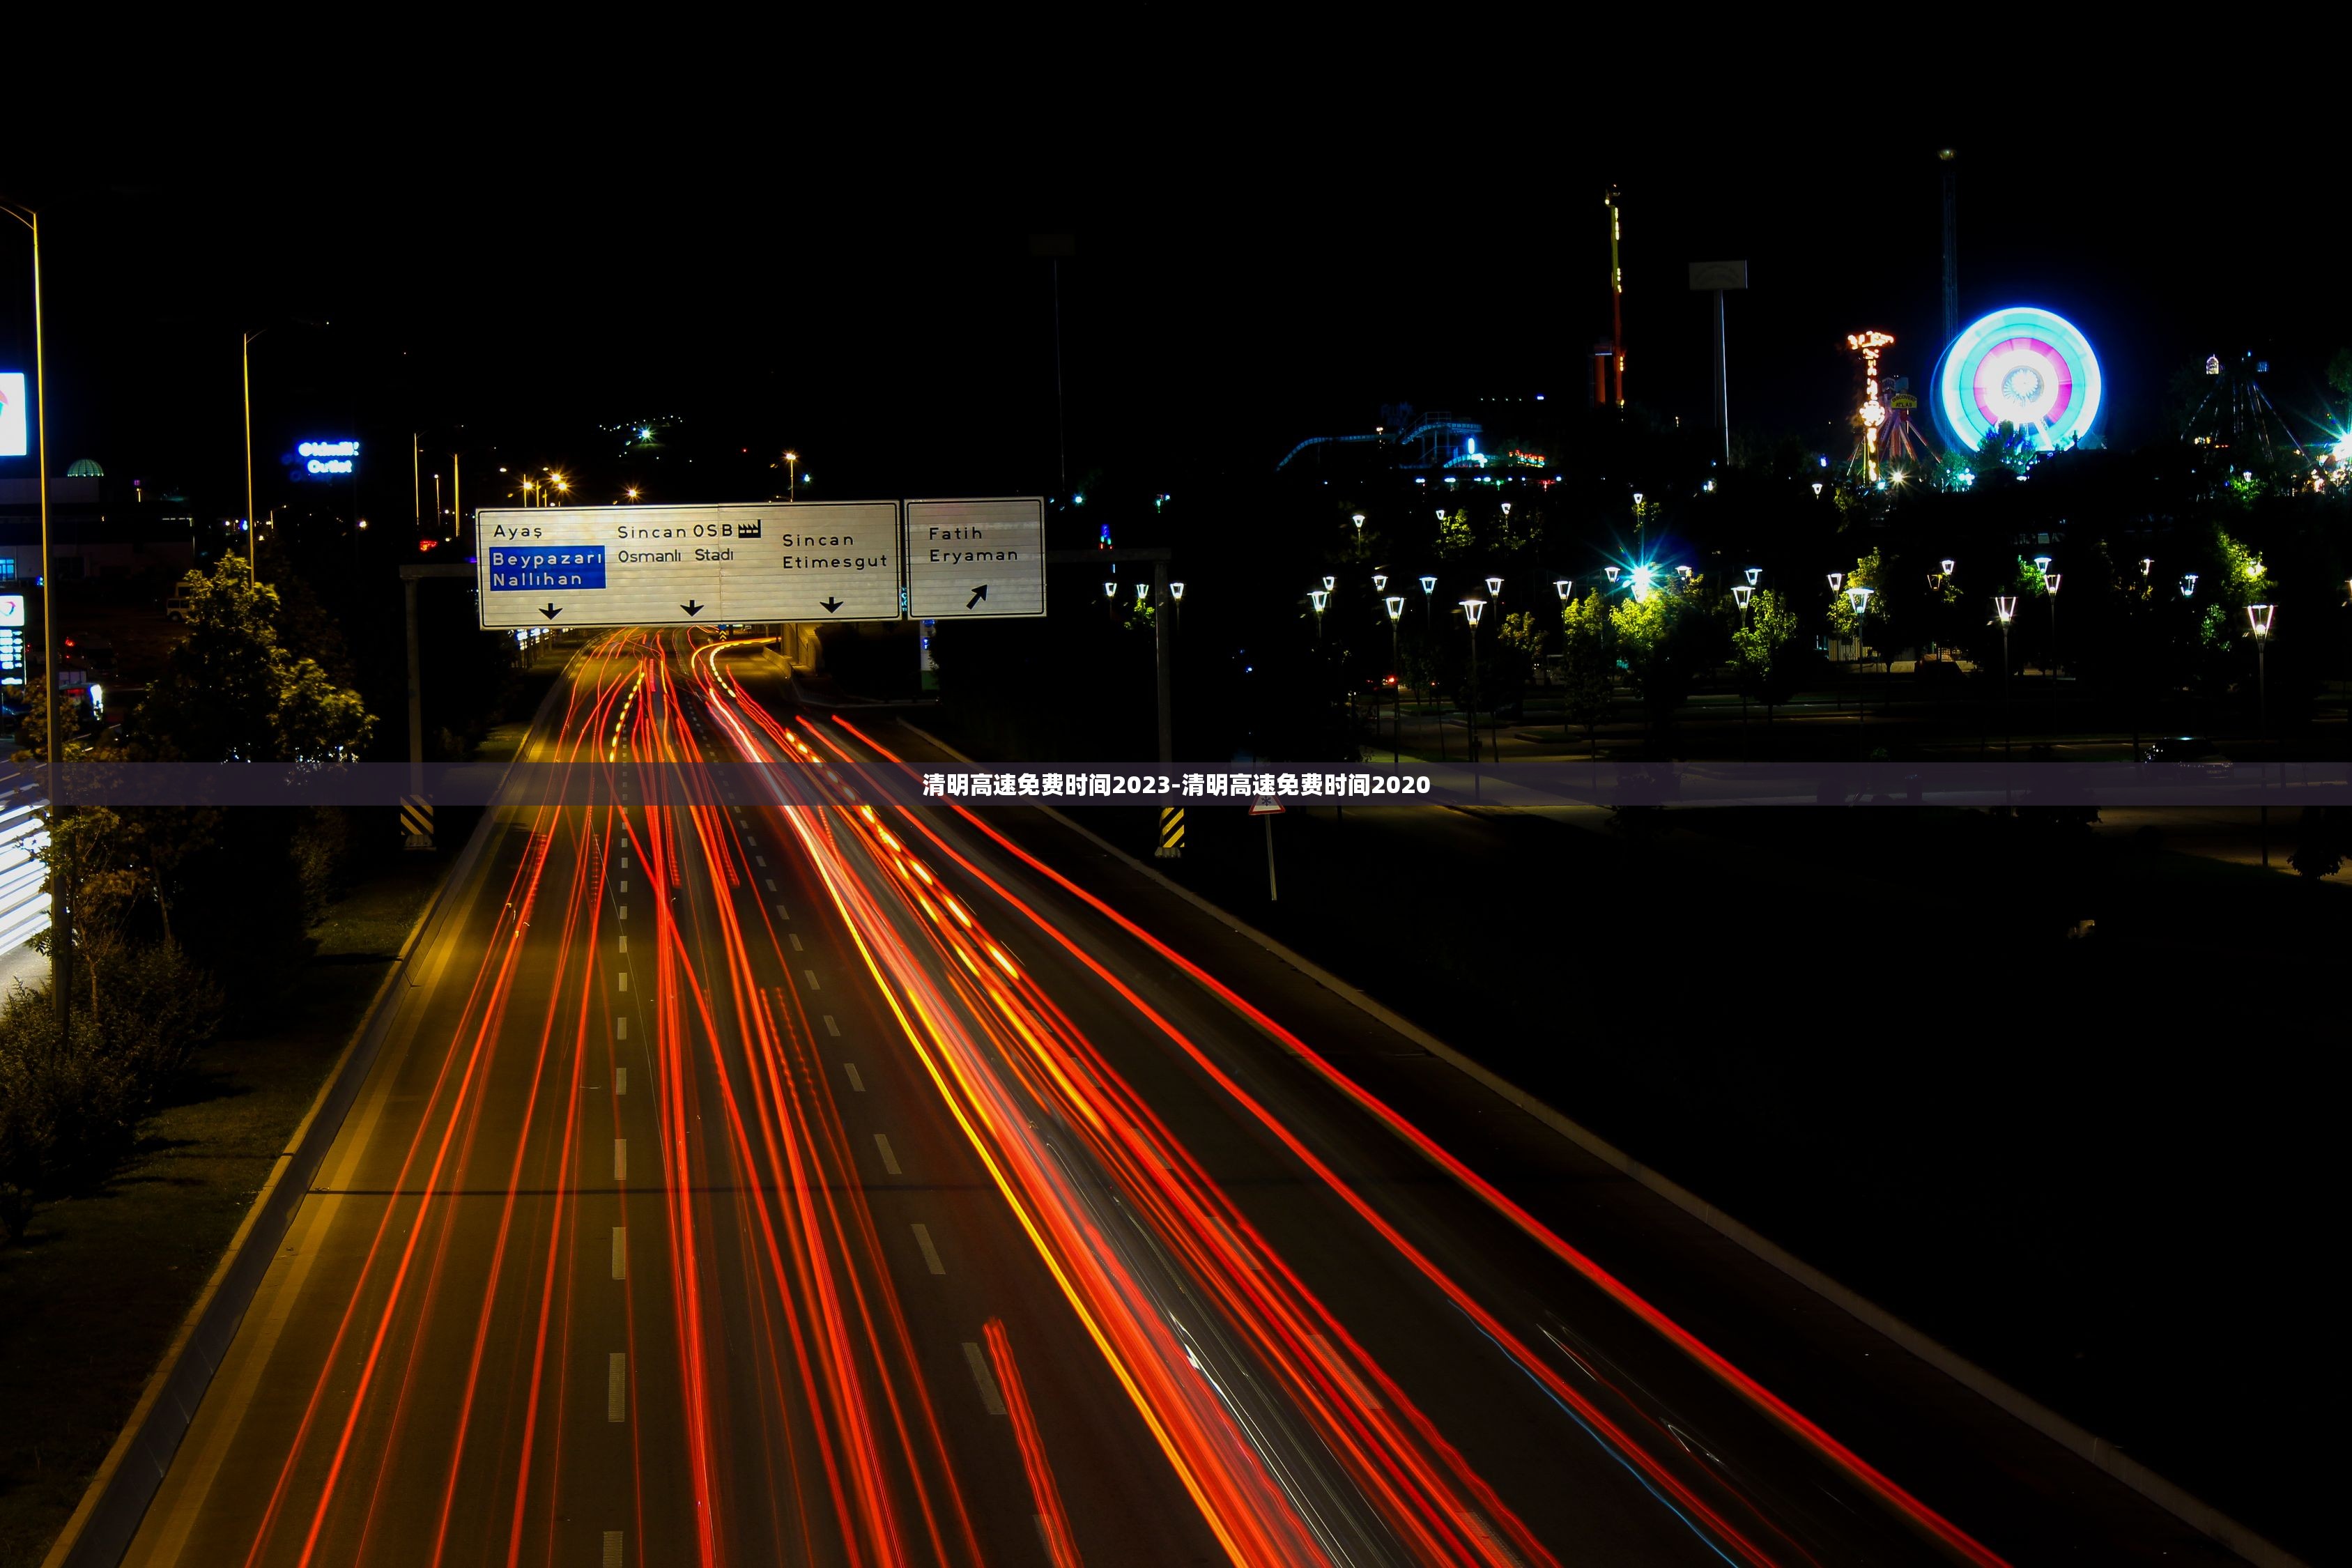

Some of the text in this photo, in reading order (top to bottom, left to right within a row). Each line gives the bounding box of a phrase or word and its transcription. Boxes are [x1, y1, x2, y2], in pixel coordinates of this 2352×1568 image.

[493, 524, 542, 540] Ayaş
[618, 524, 733, 539] Sincan OSB
[930, 527, 983, 540] Fatih
[783, 534, 854, 547] Sincan
[493, 552, 601, 569] Beypazarı
[618, 548, 734, 563] Osmanlı Stadı
[783, 555, 887, 571] Etimesgut
[930, 548, 1018, 564] Eryaman
[493, 572, 582, 587] Nallıhan
